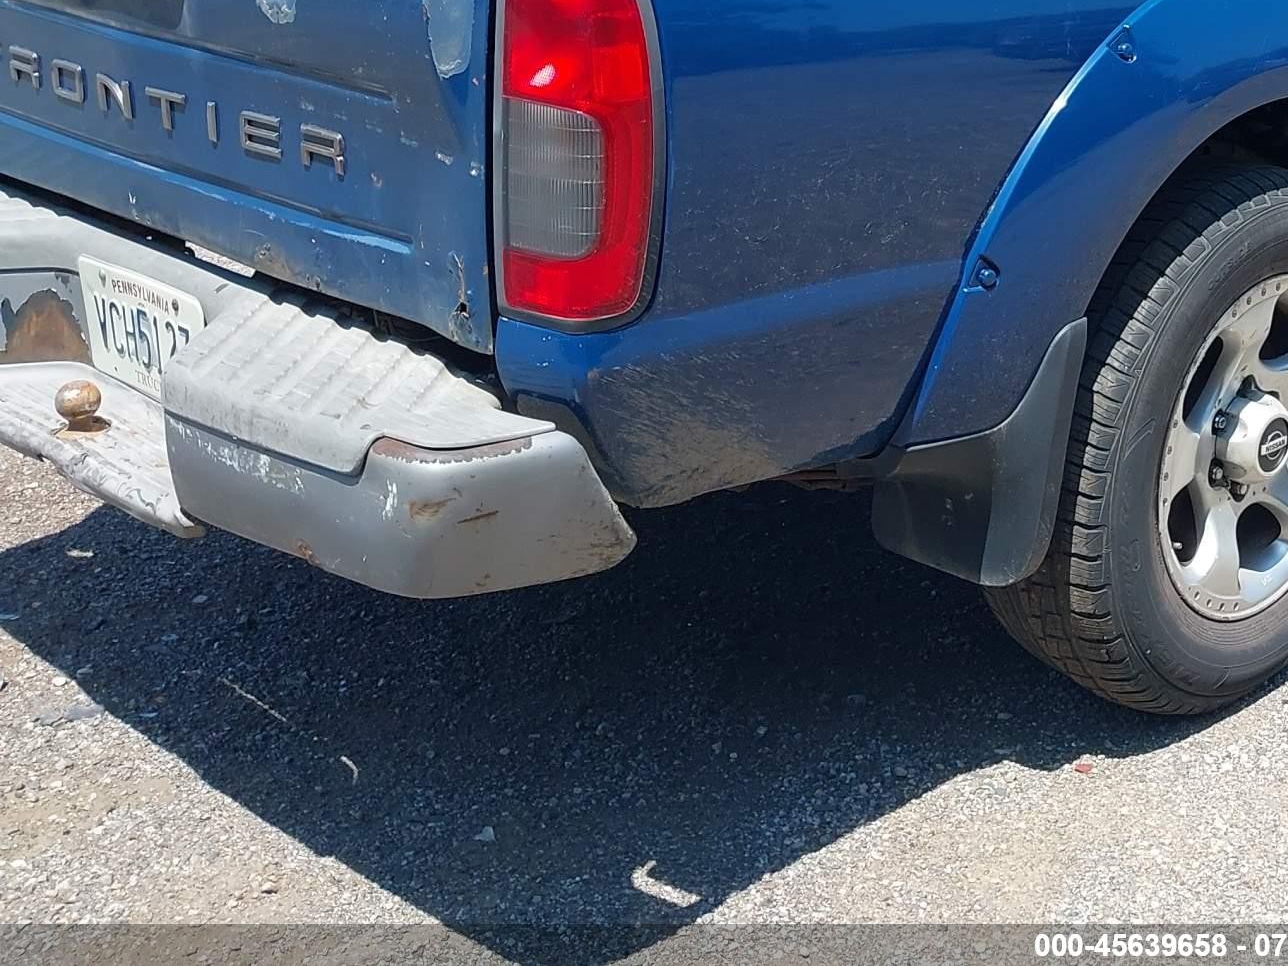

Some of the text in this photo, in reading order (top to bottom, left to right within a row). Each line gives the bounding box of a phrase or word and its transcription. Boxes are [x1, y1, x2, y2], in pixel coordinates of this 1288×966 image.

[0, 40, 346, 178] RONTIER
[111, 278, 170, 315] PENNSYLVANIA
[134, 369, 162, 393] TRUC
